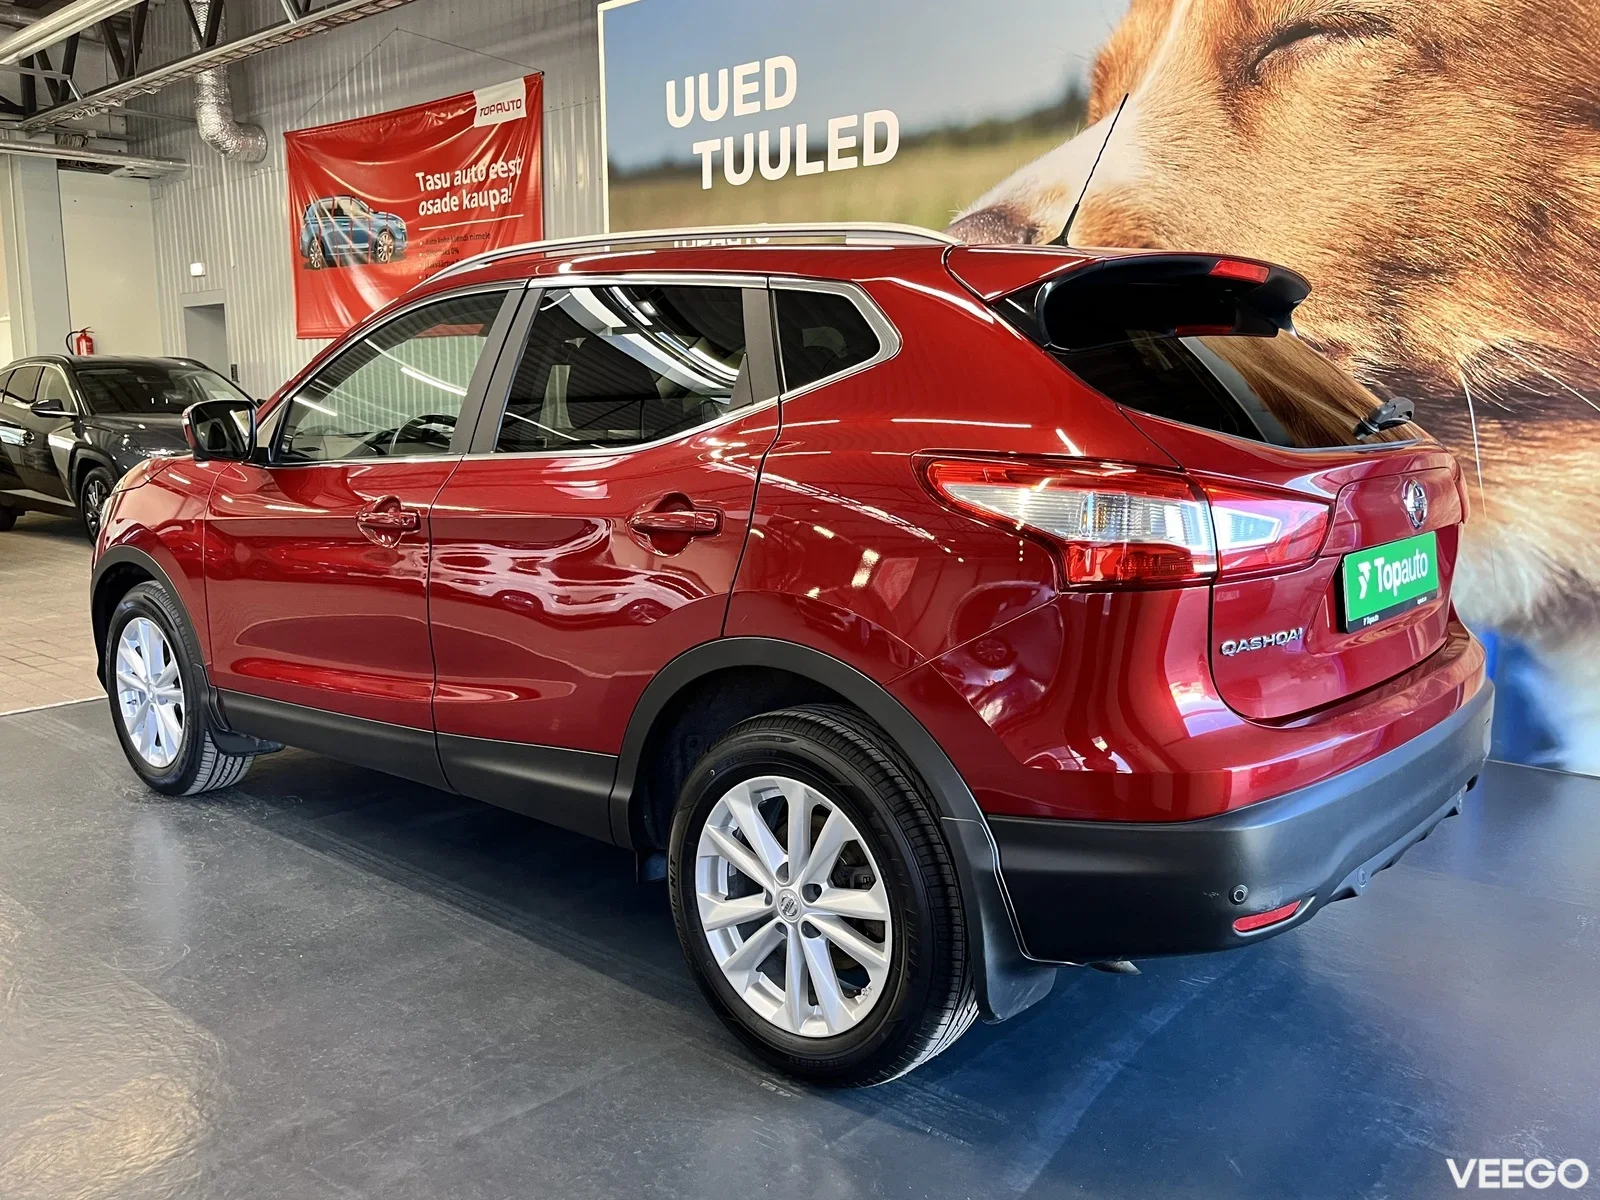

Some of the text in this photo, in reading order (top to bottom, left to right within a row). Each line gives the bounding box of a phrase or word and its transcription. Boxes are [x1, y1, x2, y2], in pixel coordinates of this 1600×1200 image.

[480, 98, 522, 117] TOPAUTO
[665, 55, 797, 128] UUED
[692, 109, 900, 190] TUULED
[415, 155, 522, 192] Tasu auto eest
[418, 182, 513, 216] osade kaupa!
[1373, 548, 1429, 597] Topauto
[1221, 627, 1303, 657] QASHQAI
